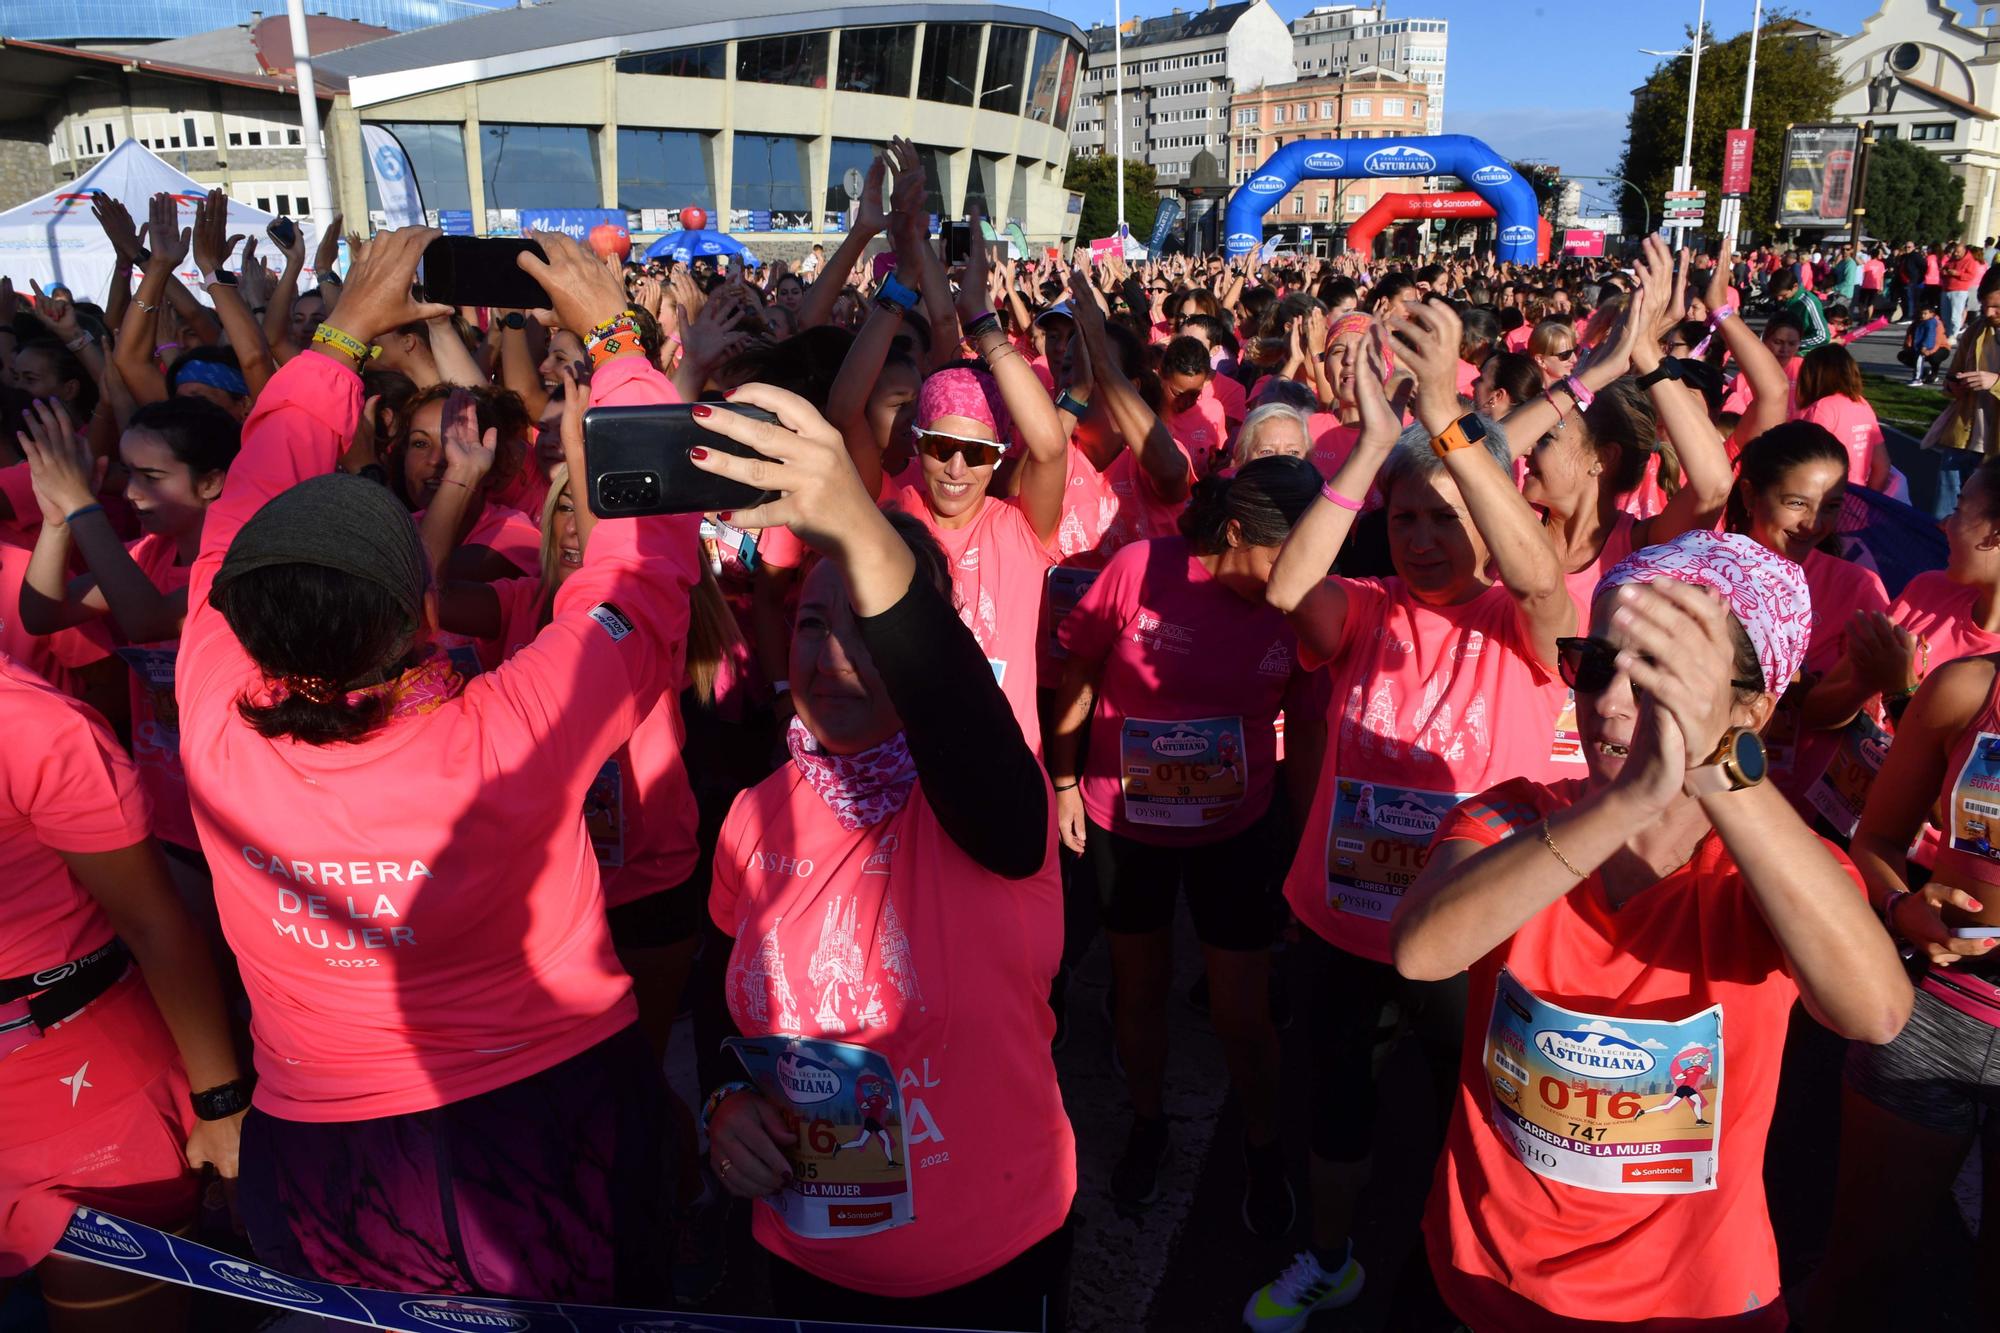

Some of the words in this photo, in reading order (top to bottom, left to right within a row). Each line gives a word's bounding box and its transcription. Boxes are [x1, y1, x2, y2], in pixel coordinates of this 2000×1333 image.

[1793, 132, 1820, 140] vueling
[1308, 158, 1341, 168] ASTURIANA
[1370, 158, 1430, 171] ASTURIANA
[1475, 173, 1509, 181] ASTURIANA
[1409, 200, 1432, 209] Sports
[1443, 199, 1482, 208] Santander
[1302, 227, 1311, 239] P
[1502, 232, 1533, 241] ASTURIANA
[1565, 240, 1590, 248] ANDAR
[606, 615, 625, 633] GOLD
[1155, 740, 1206, 752] ASTURIANA
[1157, 764, 1207, 782] 016
[1177, 786, 1190, 795] 30
[1969, 777, 2000, 793] SUMA
[1135, 807, 1171, 819] OYSHO
[1376, 809, 1436, 830] ASTURIANA
[1371, 839, 1430, 869] 016
[242, 846, 434, 885] CARRERA
[1354, 879, 1390, 894] CARRERA
[1392, 887, 1403, 896] DE
[279, 887, 330, 919] DE
[347, 894, 400, 919] LA
[1338, 893, 1382, 912] OYSHO
[272, 917, 417, 951] MUJER
[325, 958, 380, 968] 2022
[1541, 1036, 1646, 1071] ASTURIANA
[1558, 1040, 1597, 1054] CENTRAL
[1601, 1047, 1643, 1058] LECHERA
[1539, 1076, 1641, 1120] 016
[784, 1118, 835, 1154] 16
[1518, 1117, 1570, 1150] CARRERA
[1575, 1141, 1592, 1156] DE
[1596, 1145, 1612, 1156] LA
[1617, 1143, 1662, 1155] MUJER
[1568, 1122, 1608, 1141] 747
[1508, 1131, 1557, 1168] YSHO
[919, 1151, 950, 1169] 2022
[794, 1160, 817, 1179] 05
[1642, 1166, 1684, 1176] Santander
[803, 1184, 818, 1196] LA
[821, 1184, 861, 1197] MUJER
[847, 1209, 885, 1219] Santander
[66, 1226, 141, 1256] STURIANA
[221, 1267, 315, 1302] ASTURIANA
[412, 1304, 521, 1328] ASTURIANA
